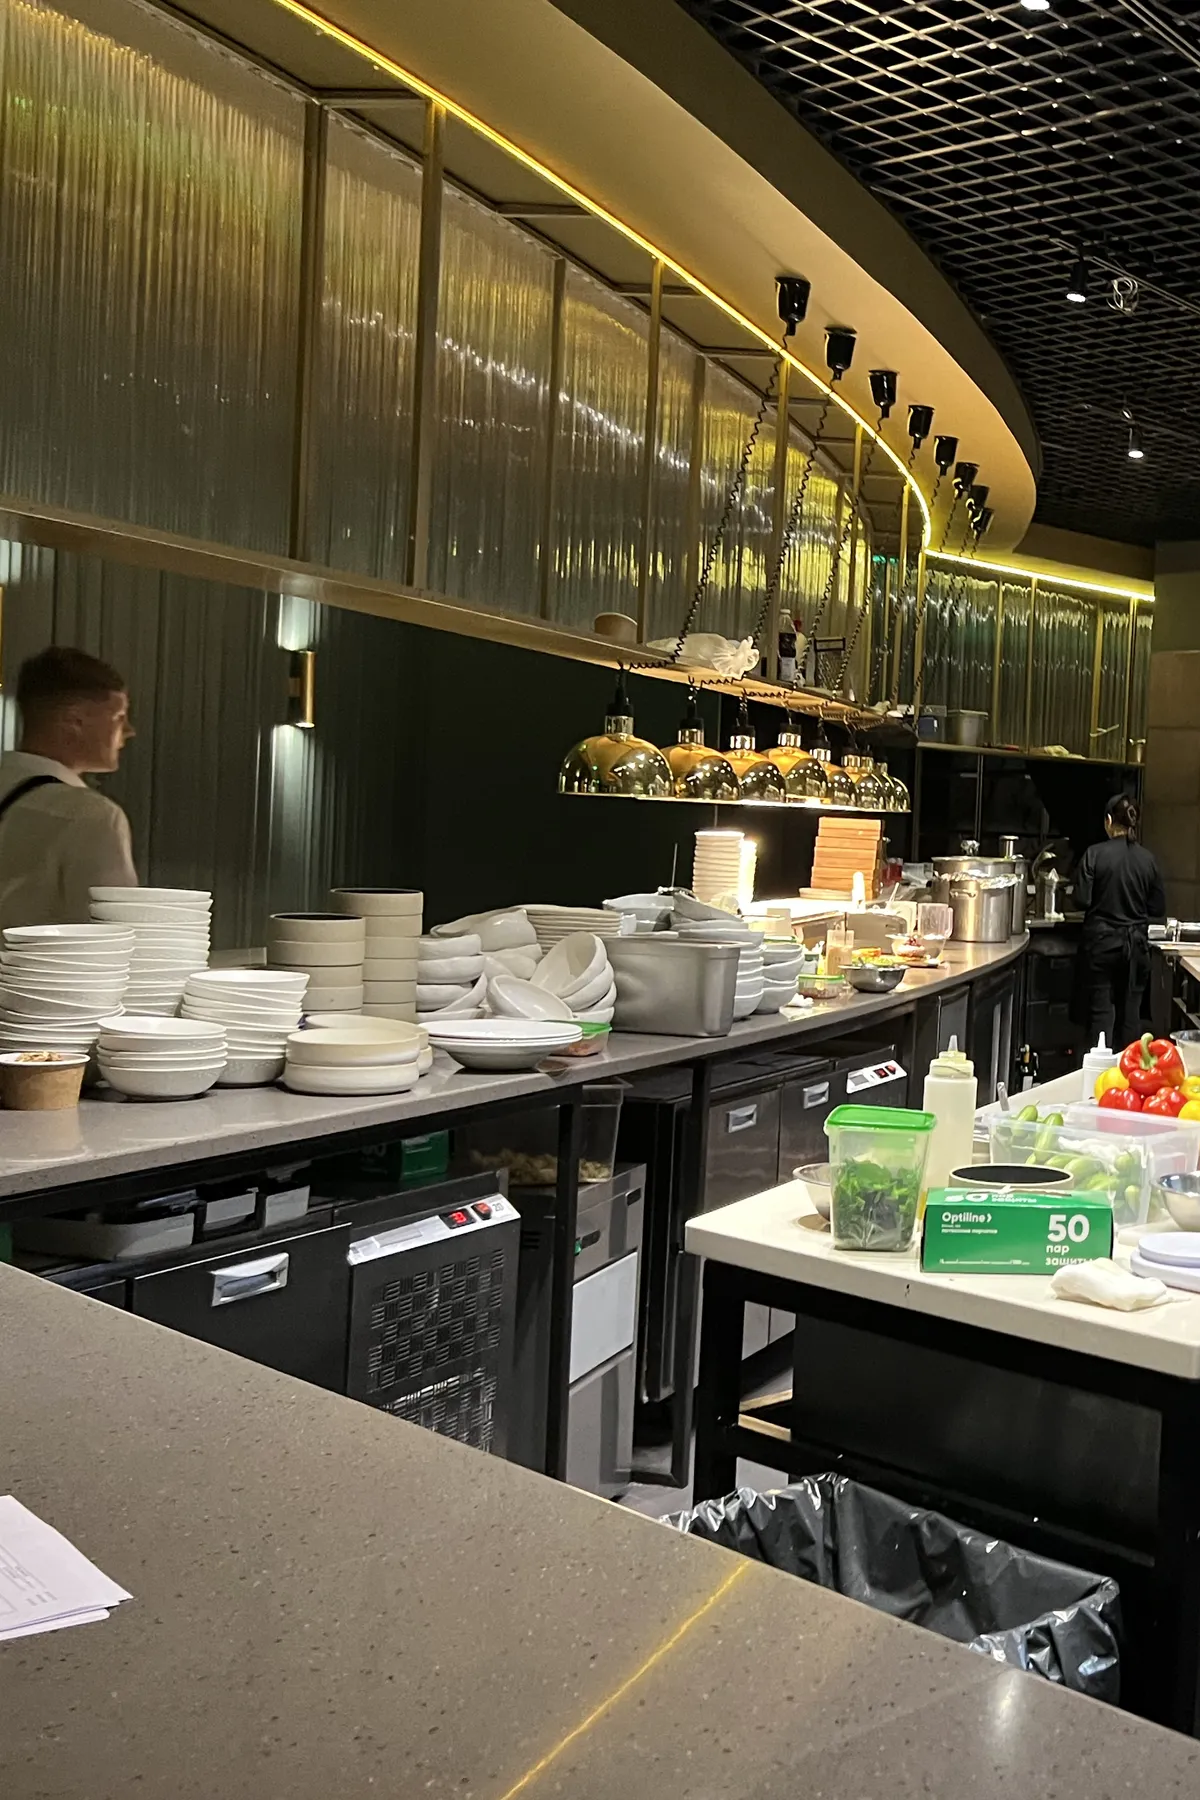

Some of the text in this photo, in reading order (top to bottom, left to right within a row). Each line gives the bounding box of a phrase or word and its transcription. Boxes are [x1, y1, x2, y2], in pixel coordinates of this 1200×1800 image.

[942, 1211, 986, 1224] Optiline
[1047, 1214, 1090, 1243] 50
[1046, 1245, 1070, 1256] пар
